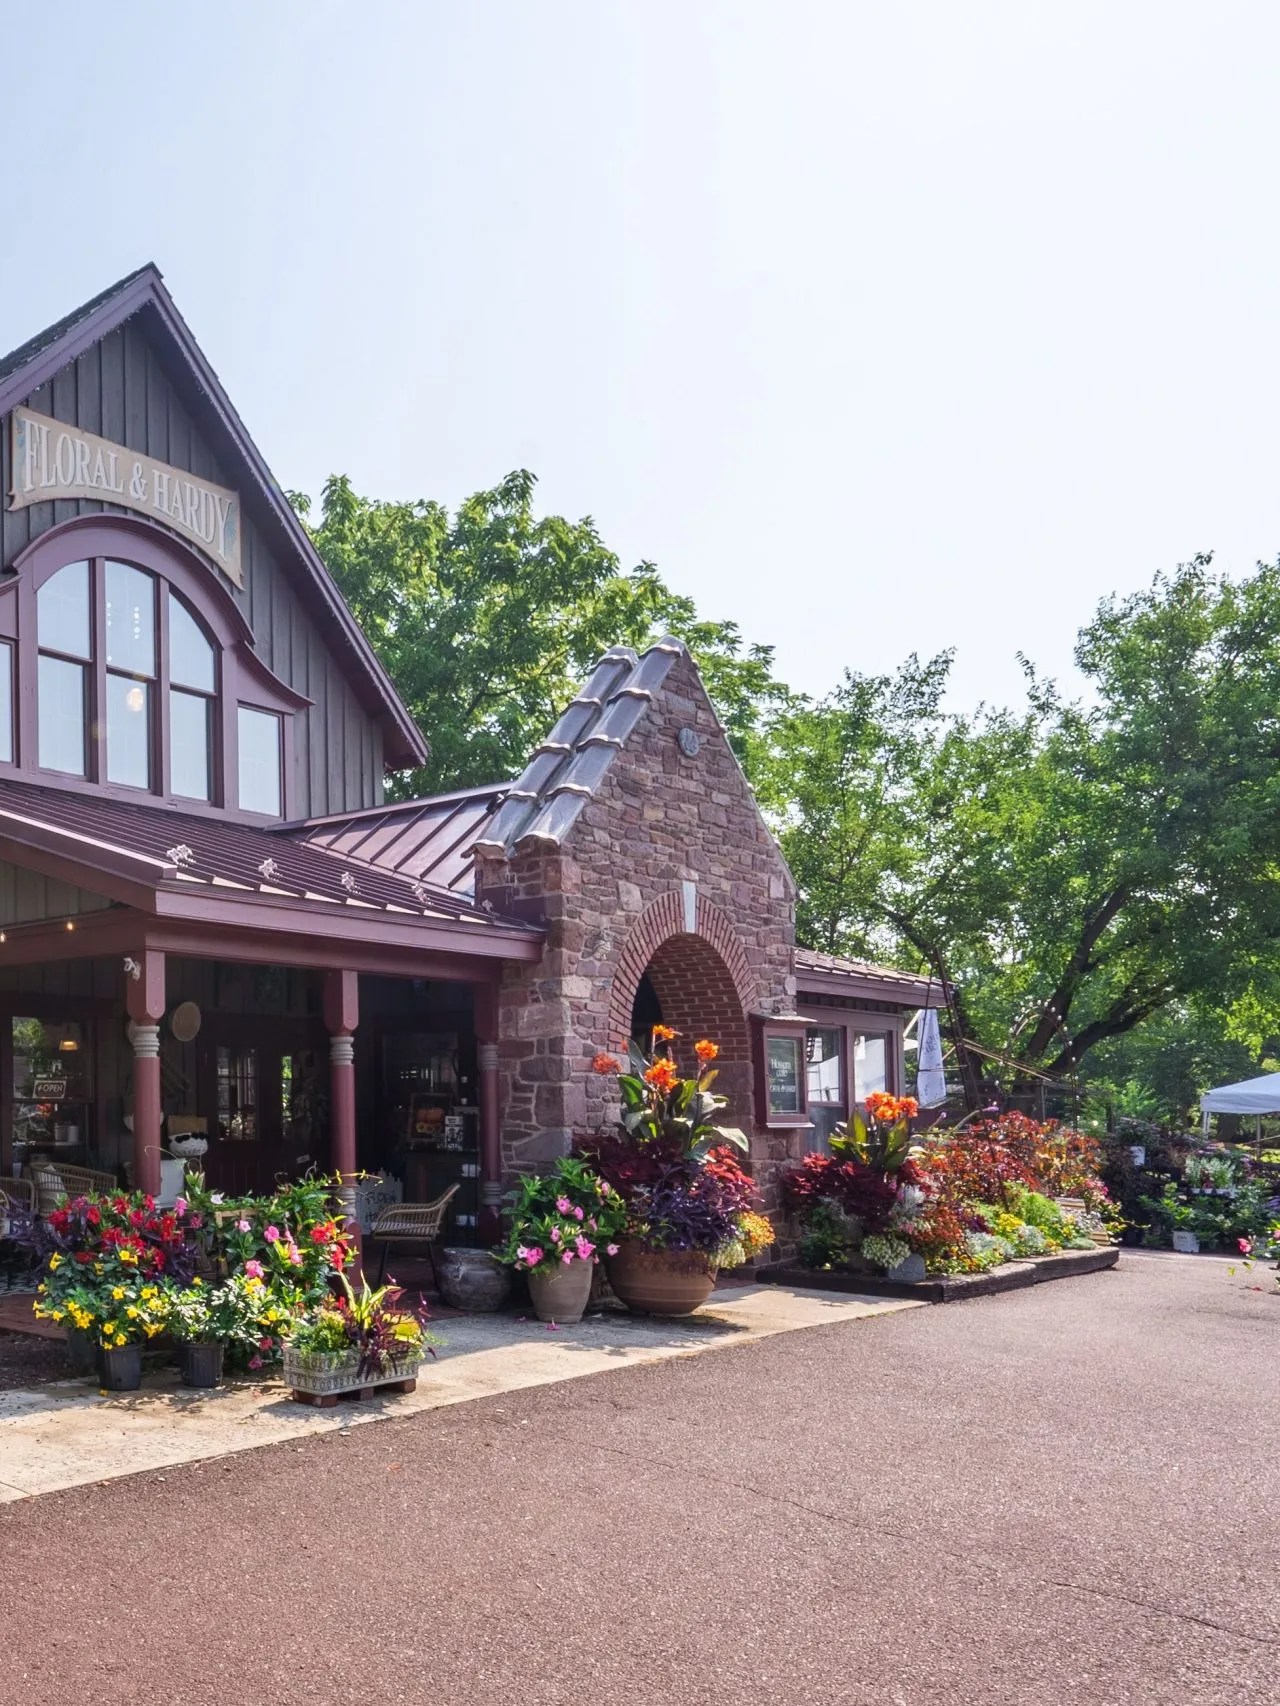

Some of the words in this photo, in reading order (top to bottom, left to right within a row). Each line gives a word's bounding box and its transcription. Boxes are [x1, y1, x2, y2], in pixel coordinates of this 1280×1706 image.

[23, 418, 124, 494] FLORAL
[129, 462, 148, 501] &
[152, 469, 233, 562] HARDY
[43, 1084, 63, 1093] OPEN
